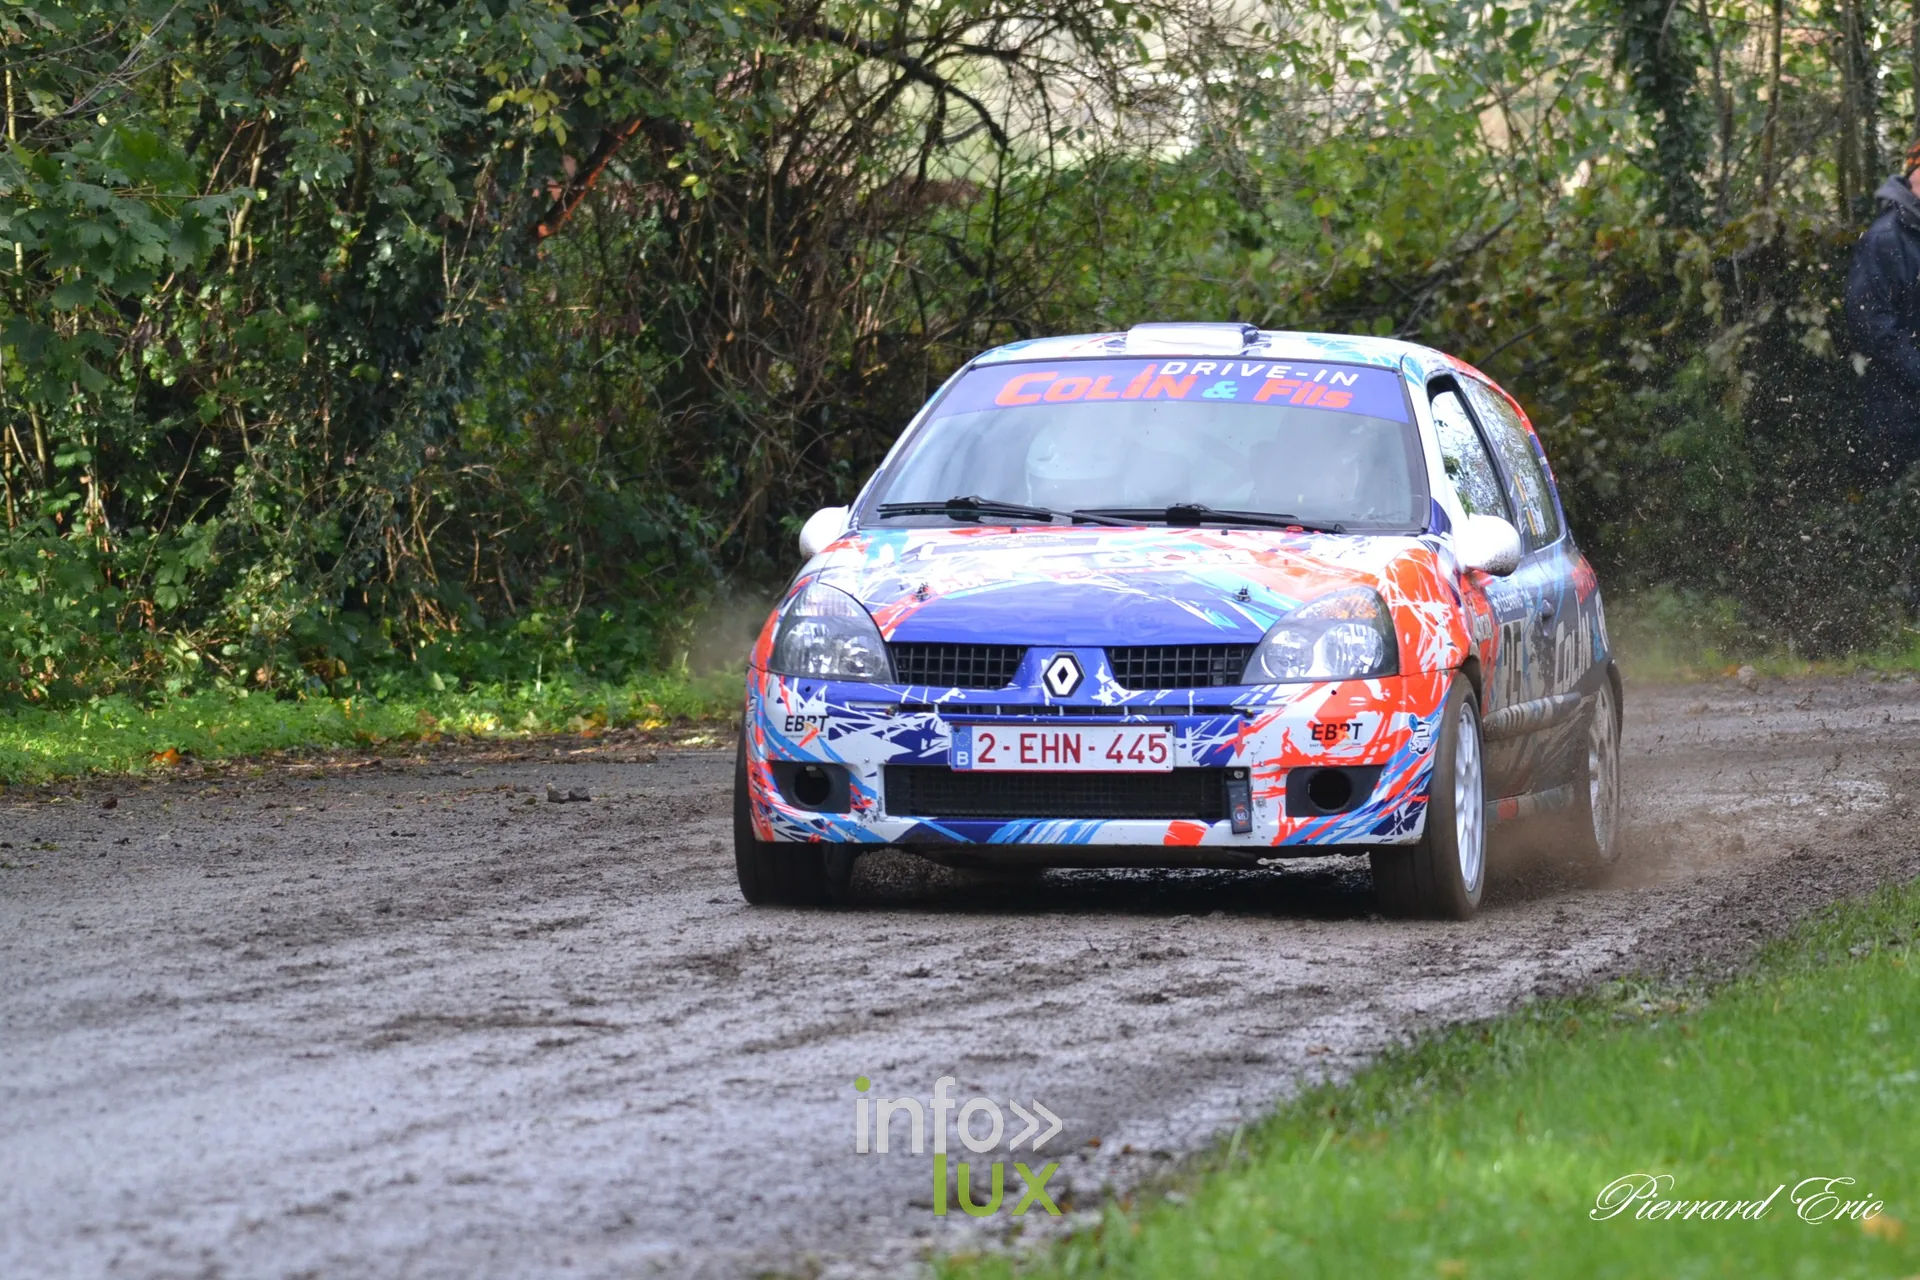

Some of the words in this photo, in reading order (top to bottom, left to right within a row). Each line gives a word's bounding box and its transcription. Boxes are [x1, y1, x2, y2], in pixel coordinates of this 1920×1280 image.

[1160, 361, 1359, 387] DRIVE-IN
[1202, 381, 1239, 399] &
[1253, 378, 1353, 408] Fils
[956, 751, 969, 766] B
[977, 732, 1167, 765] 2-EHN-445
